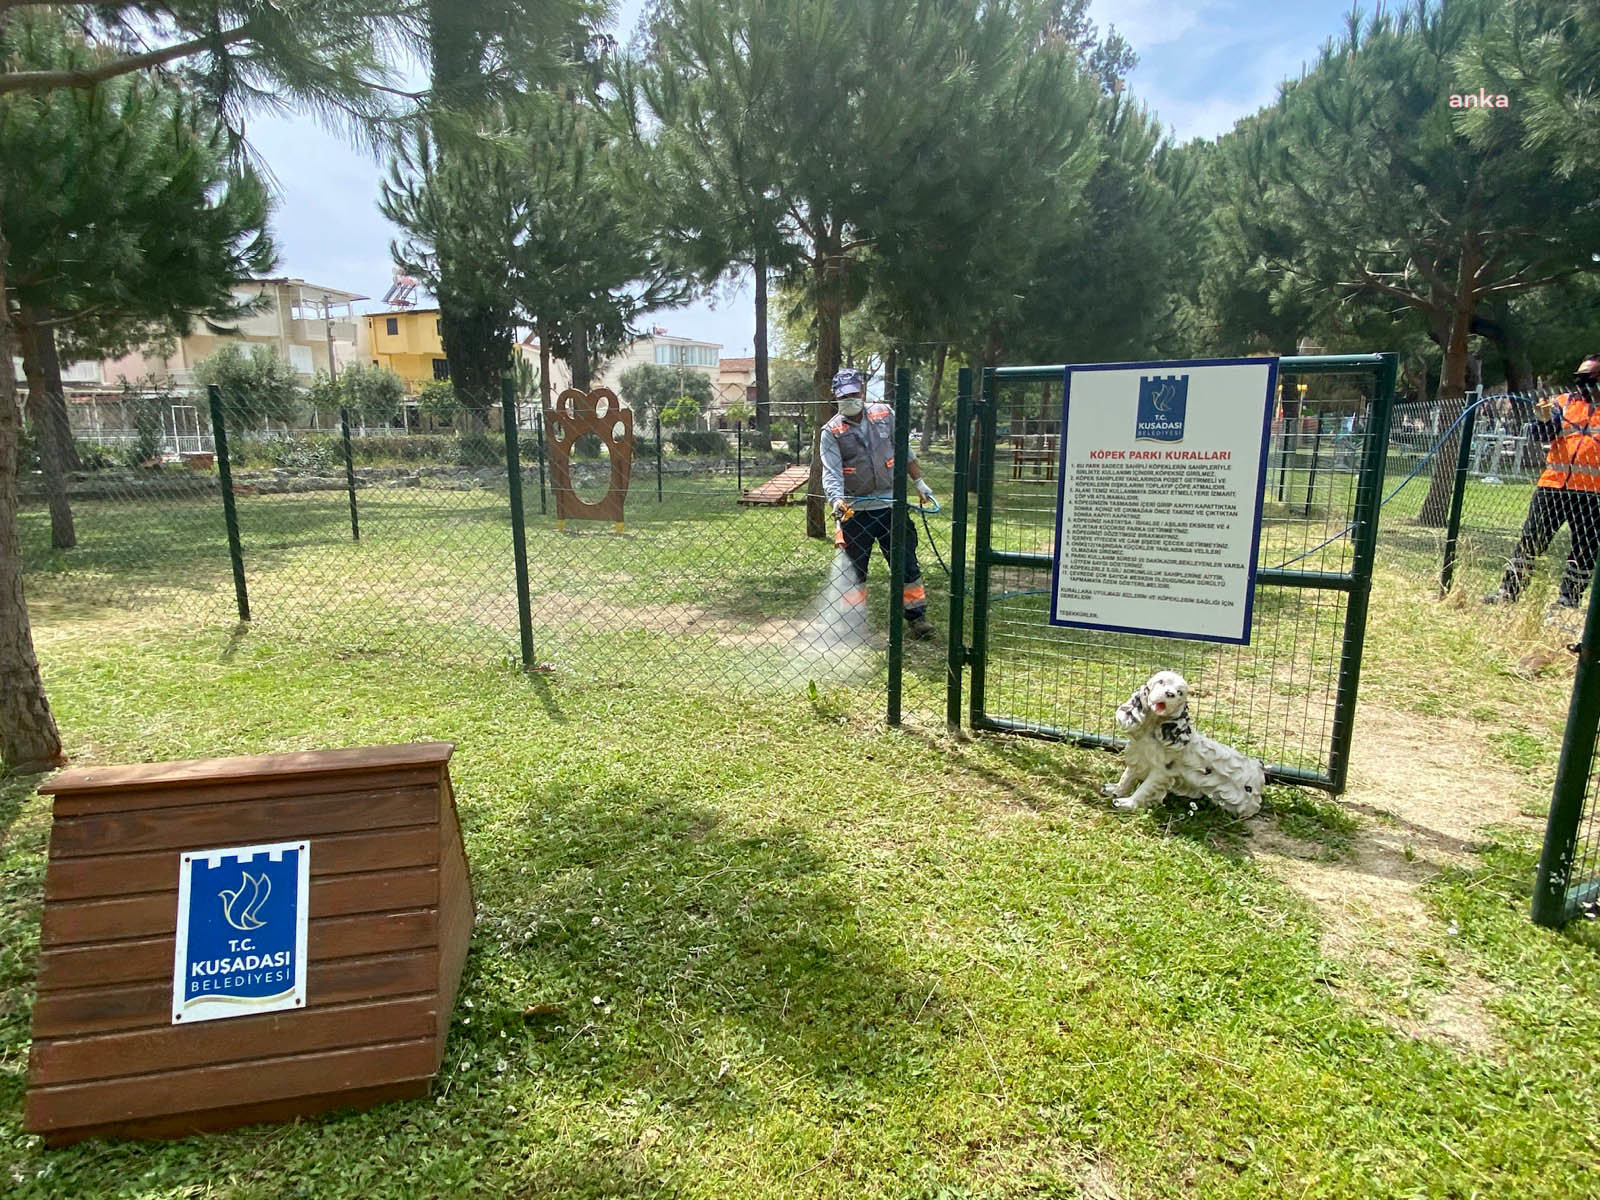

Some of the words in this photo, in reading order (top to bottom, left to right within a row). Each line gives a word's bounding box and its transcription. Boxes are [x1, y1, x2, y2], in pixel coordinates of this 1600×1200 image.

[1089, 450, 1125, 458] KÖPEK
[1128, 450, 1161, 459] PARKI
[1165, 450, 1231, 459] KURALLARI
[228, 938, 256, 953] T.C.
[191, 968, 290, 992] BELEDİYESİ
